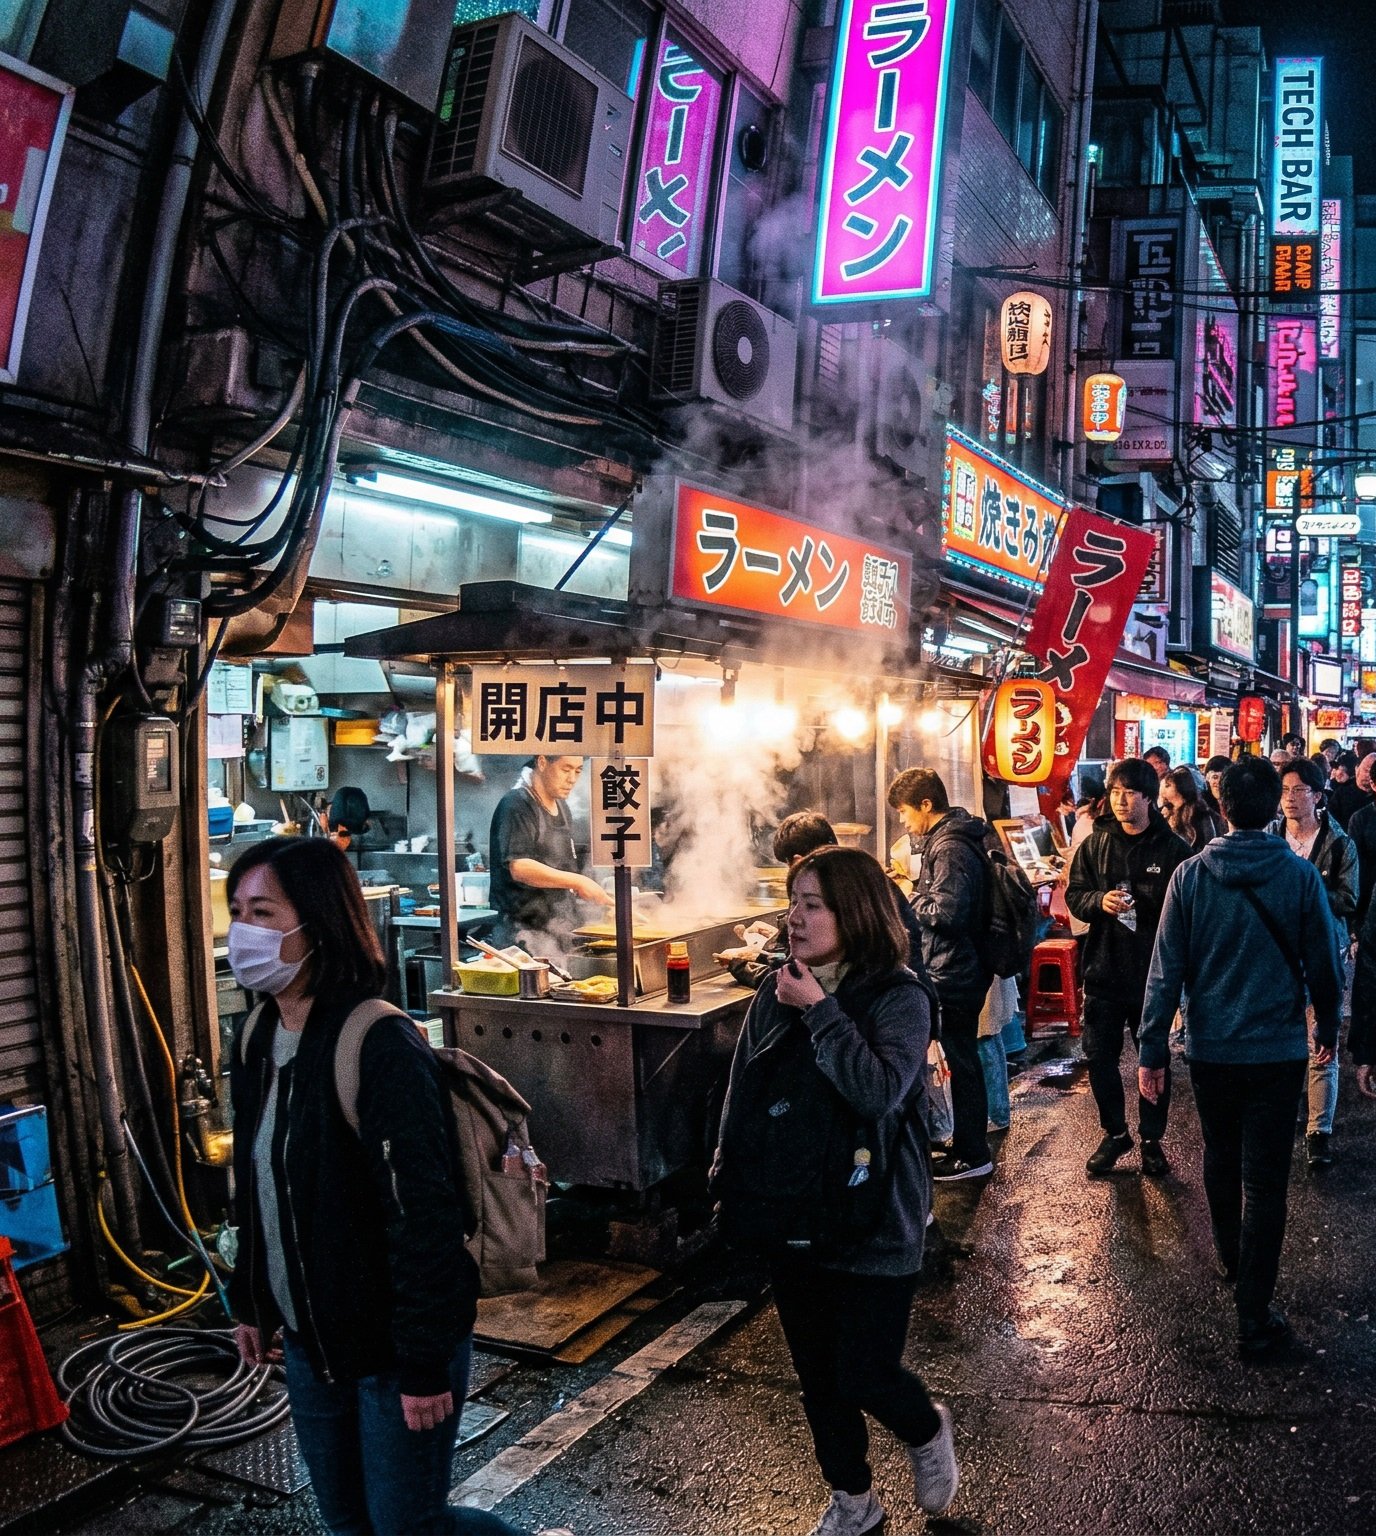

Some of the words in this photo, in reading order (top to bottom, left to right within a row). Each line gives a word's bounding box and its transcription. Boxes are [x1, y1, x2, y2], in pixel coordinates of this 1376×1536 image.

[839, 0, 930, 282] ラーメン
[1281, 70, 1314, 148] TECH
[1279, 159, 1313, 222] BAR
[697, 509, 849, 611] ラーメン
[480, 682, 644, 743] 開店中
[600, 765, 641, 859] 餃子
